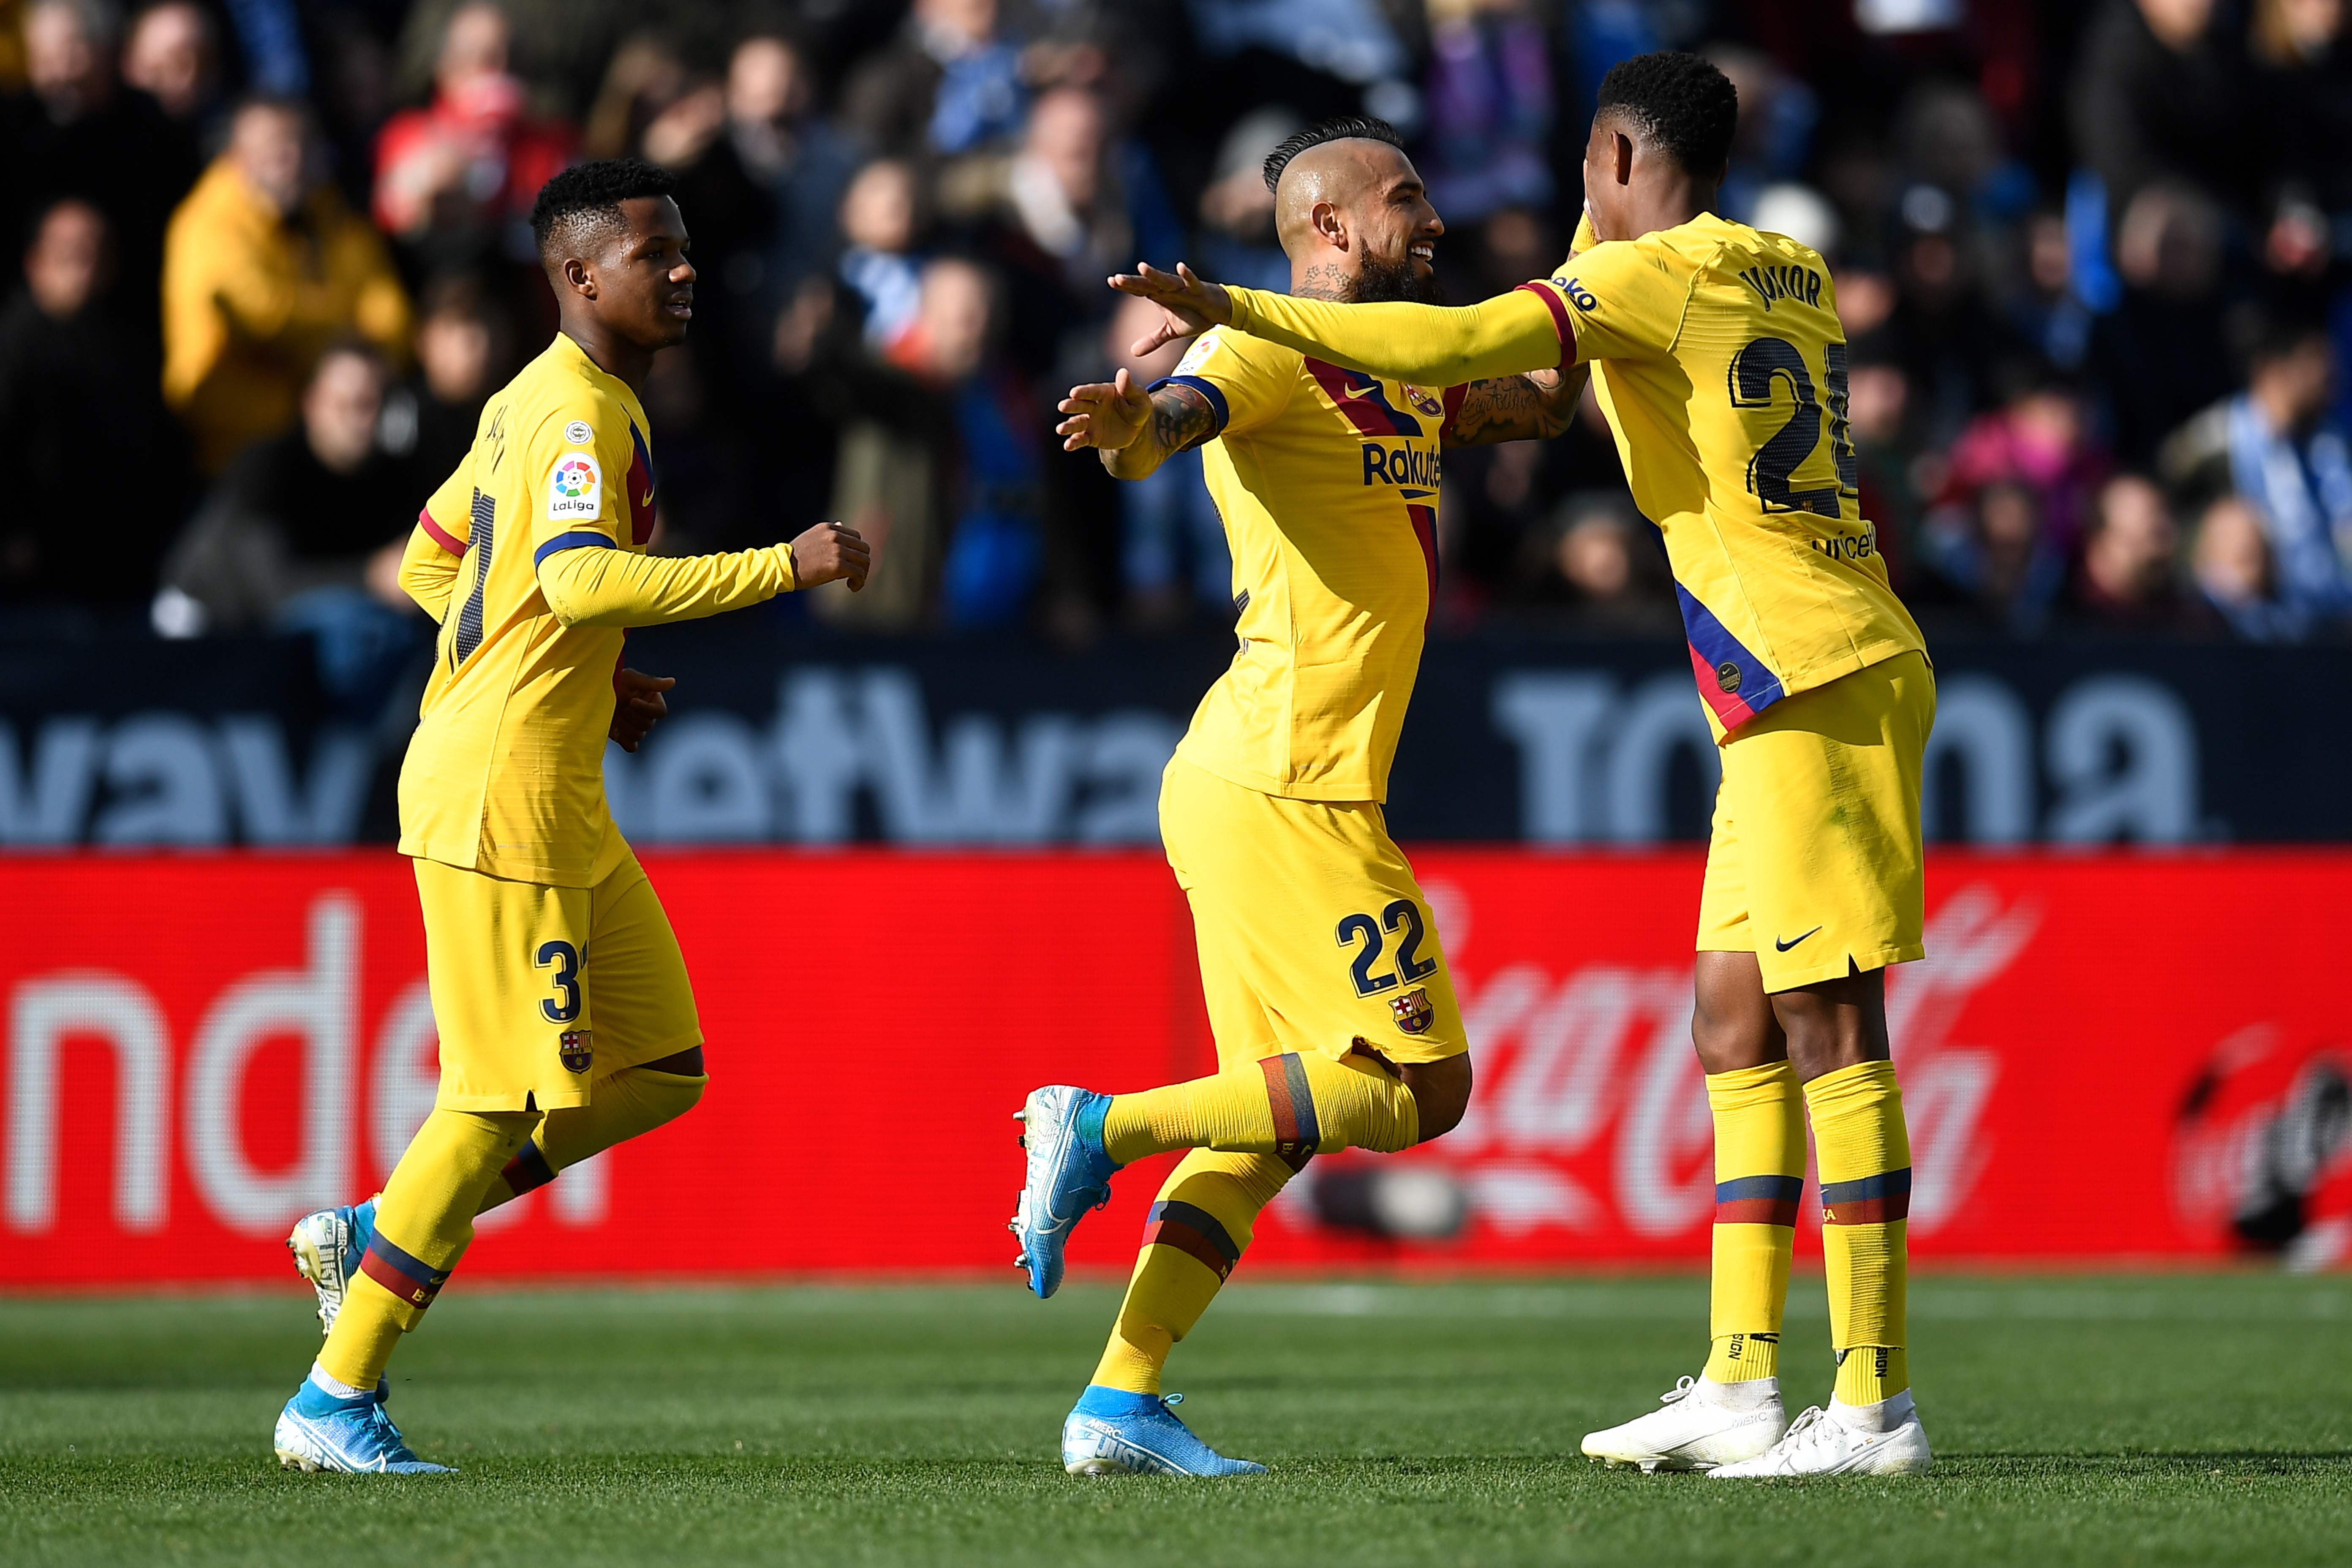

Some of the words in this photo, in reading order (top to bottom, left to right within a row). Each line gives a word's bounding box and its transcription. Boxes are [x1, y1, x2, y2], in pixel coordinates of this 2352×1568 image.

[1549, 277, 1597, 311] eko
[553, 499, 594, 511] LaLiga
[1335, 899, 1438, 999] 22
[534, 939, 588, 1024] 3
[1728, 1334, 1744, 1360] SIGN
[1875, 1347, 1888, 1378] SIGN
